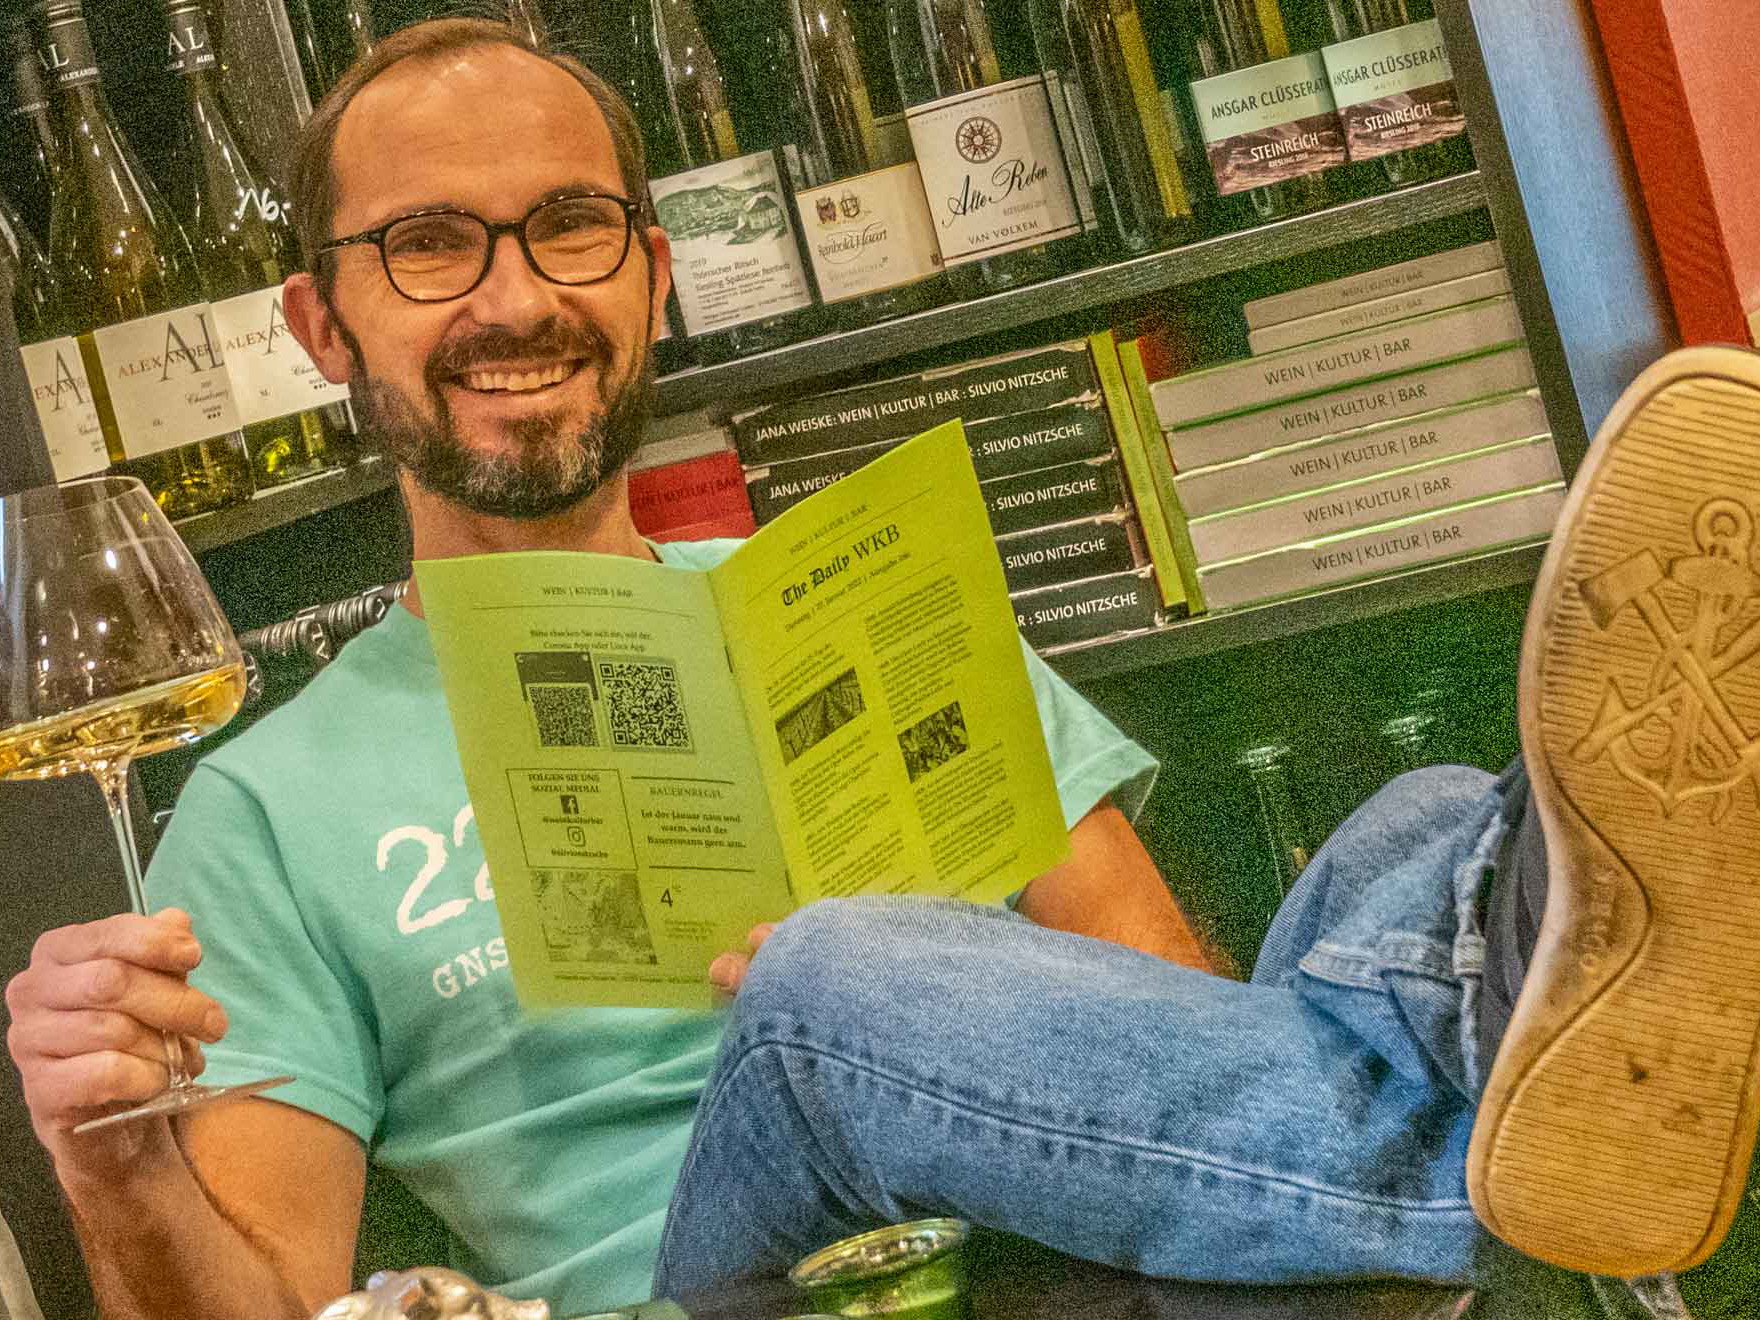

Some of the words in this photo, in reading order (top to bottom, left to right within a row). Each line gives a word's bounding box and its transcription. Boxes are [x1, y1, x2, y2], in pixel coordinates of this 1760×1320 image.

[168, 26, 205, 57] AL
[1210, 95, 1258, 121] ANSGAR
[1364, 102, 1433, 132] STEINREICH
[1250, 131, 1319, 161] STEINREICH
[942, 174, 987, 230] Alte
[989, 159, 1049, 203] Reben
[968, 231, 991, 246] VAN
[993, 219, 1039, 237] VOLXEM
[160, 311, 225, 383] AL
[1265, 365, 1305, 385] WEIN
[1315, 348, 1373, 373] KULTUR
[1383, 338, 1411, 356] BAR
[755, 423, 788, 442] JANA
[788, 414, 838, 435] WEISKE:
[838, 406, 872, 425] WEIN
[880, 394, 928, 416] KULTUR
[935, 388, 960, 405] BAR
[968, 379, 1007, 399] SILVIO
[1008, 366, 1070, 391] NITZSCHE
[1279, 409, 1321, 431] WEIN
[1330, 393, 1389, 418] KULTUR
[1397, 383, 1427, 402] BAR
[982, 436, 1021, 456] SILVIO
[1022, 423, 1085, 447] NITZSCHE
[1289, 455, 1332, 477] WEIN
[1341, 440, 1400, 465] KULTUR
[1408, 431, 1439, 449] BAR
[768, 481, 801, 499] JANA
[996, 491, 1035, 511] SILVIO
[1036, 478, 1098, 502] NITZSCHE
[1303, 502, 1344, 524] WEIN
[1354, 486, 1412, 512] KULTUR
[1422, 476, 1452, 496] BAR
[1006, 551, 1045, 570] SILVIO
[1045, 538, 1108, 561] NITZSCHE
[1312, 549, 1353, 571] WEIN
[1364, 534, 1422, 560] KULTUR
[1432, 525, 1463, 544] BAR
[781, 581, 809, 607] The
[808, 553, 850, 589] Daily
[852, 523, 901, 561] WKB
[1034, 605, 1074, 625] SILVIO
[1075, 592, 1138, 615] NITZSCHE
